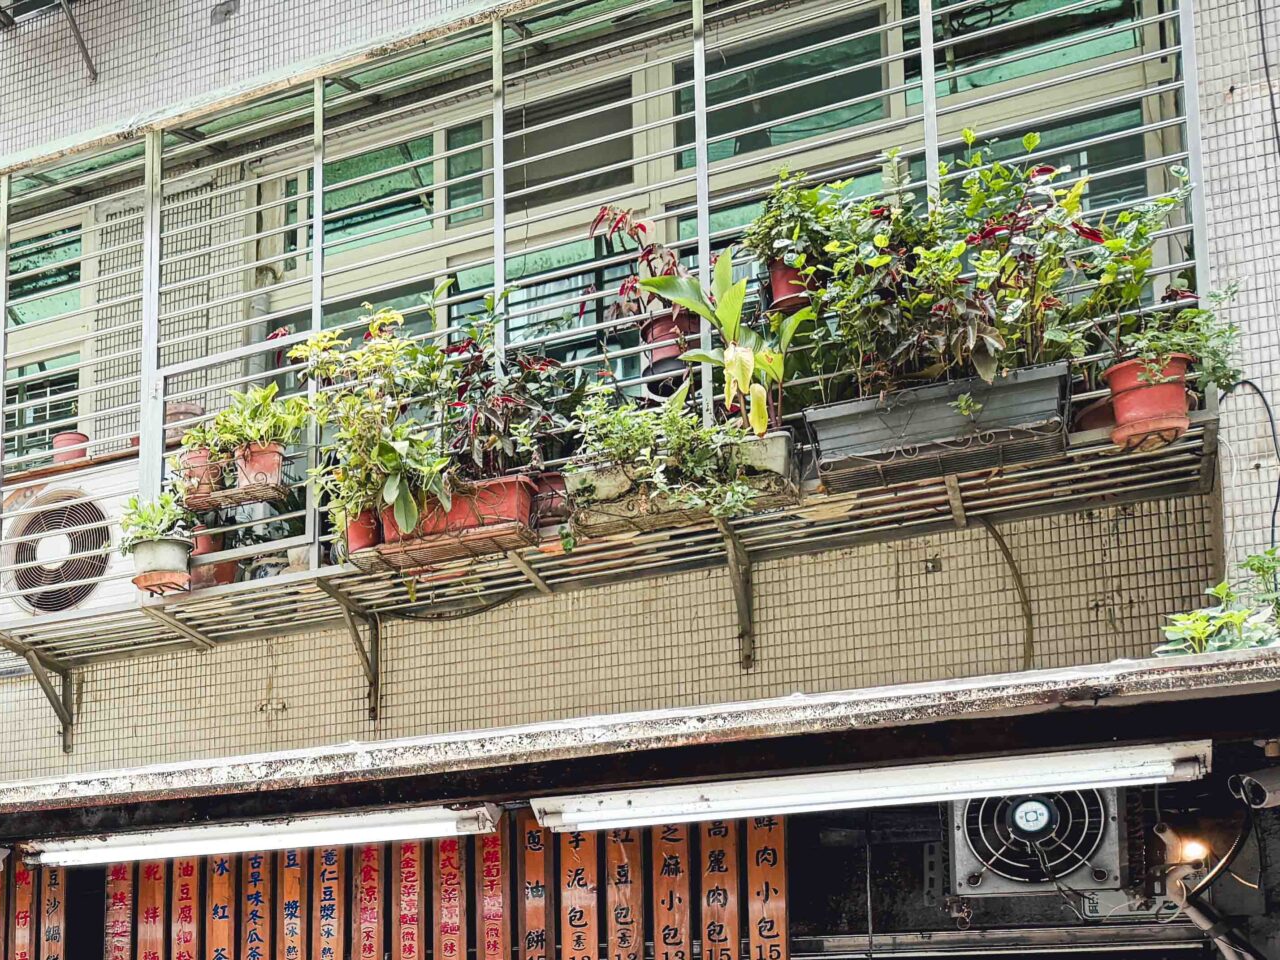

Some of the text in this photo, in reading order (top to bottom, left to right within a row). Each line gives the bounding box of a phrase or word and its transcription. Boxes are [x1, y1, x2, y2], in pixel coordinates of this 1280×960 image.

[660, 824, 684, 947] 芝麻小包
[706, 820, 729, 943] 高麗肉包
[753, 816, 781, 960] 鮮肉小包 15
